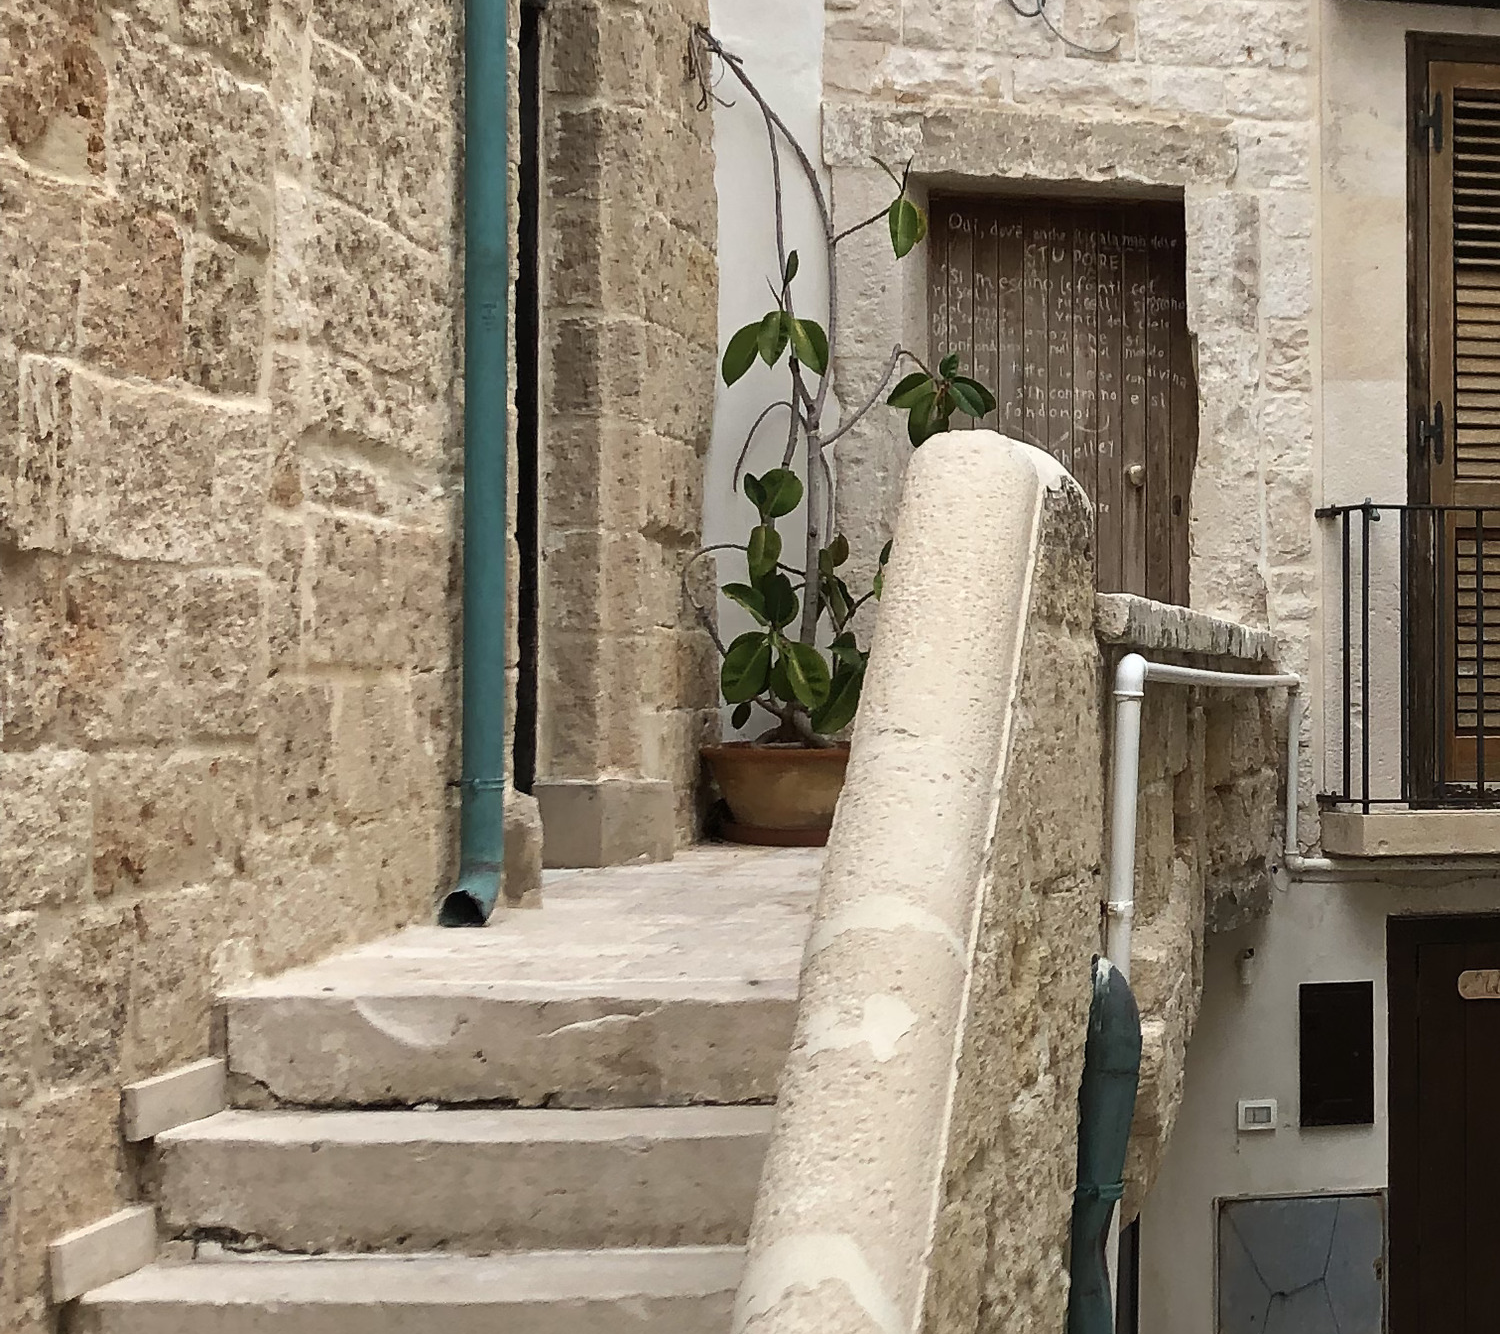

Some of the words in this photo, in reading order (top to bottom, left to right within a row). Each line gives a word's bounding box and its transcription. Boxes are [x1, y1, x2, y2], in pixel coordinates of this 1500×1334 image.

[1025, 243, 1119, 269] STUPORE
[1077, 276, 1121, 296] fonti
[1130, 393, 1140, 405] e
[1053, 438, 1115, 465] Shelley
